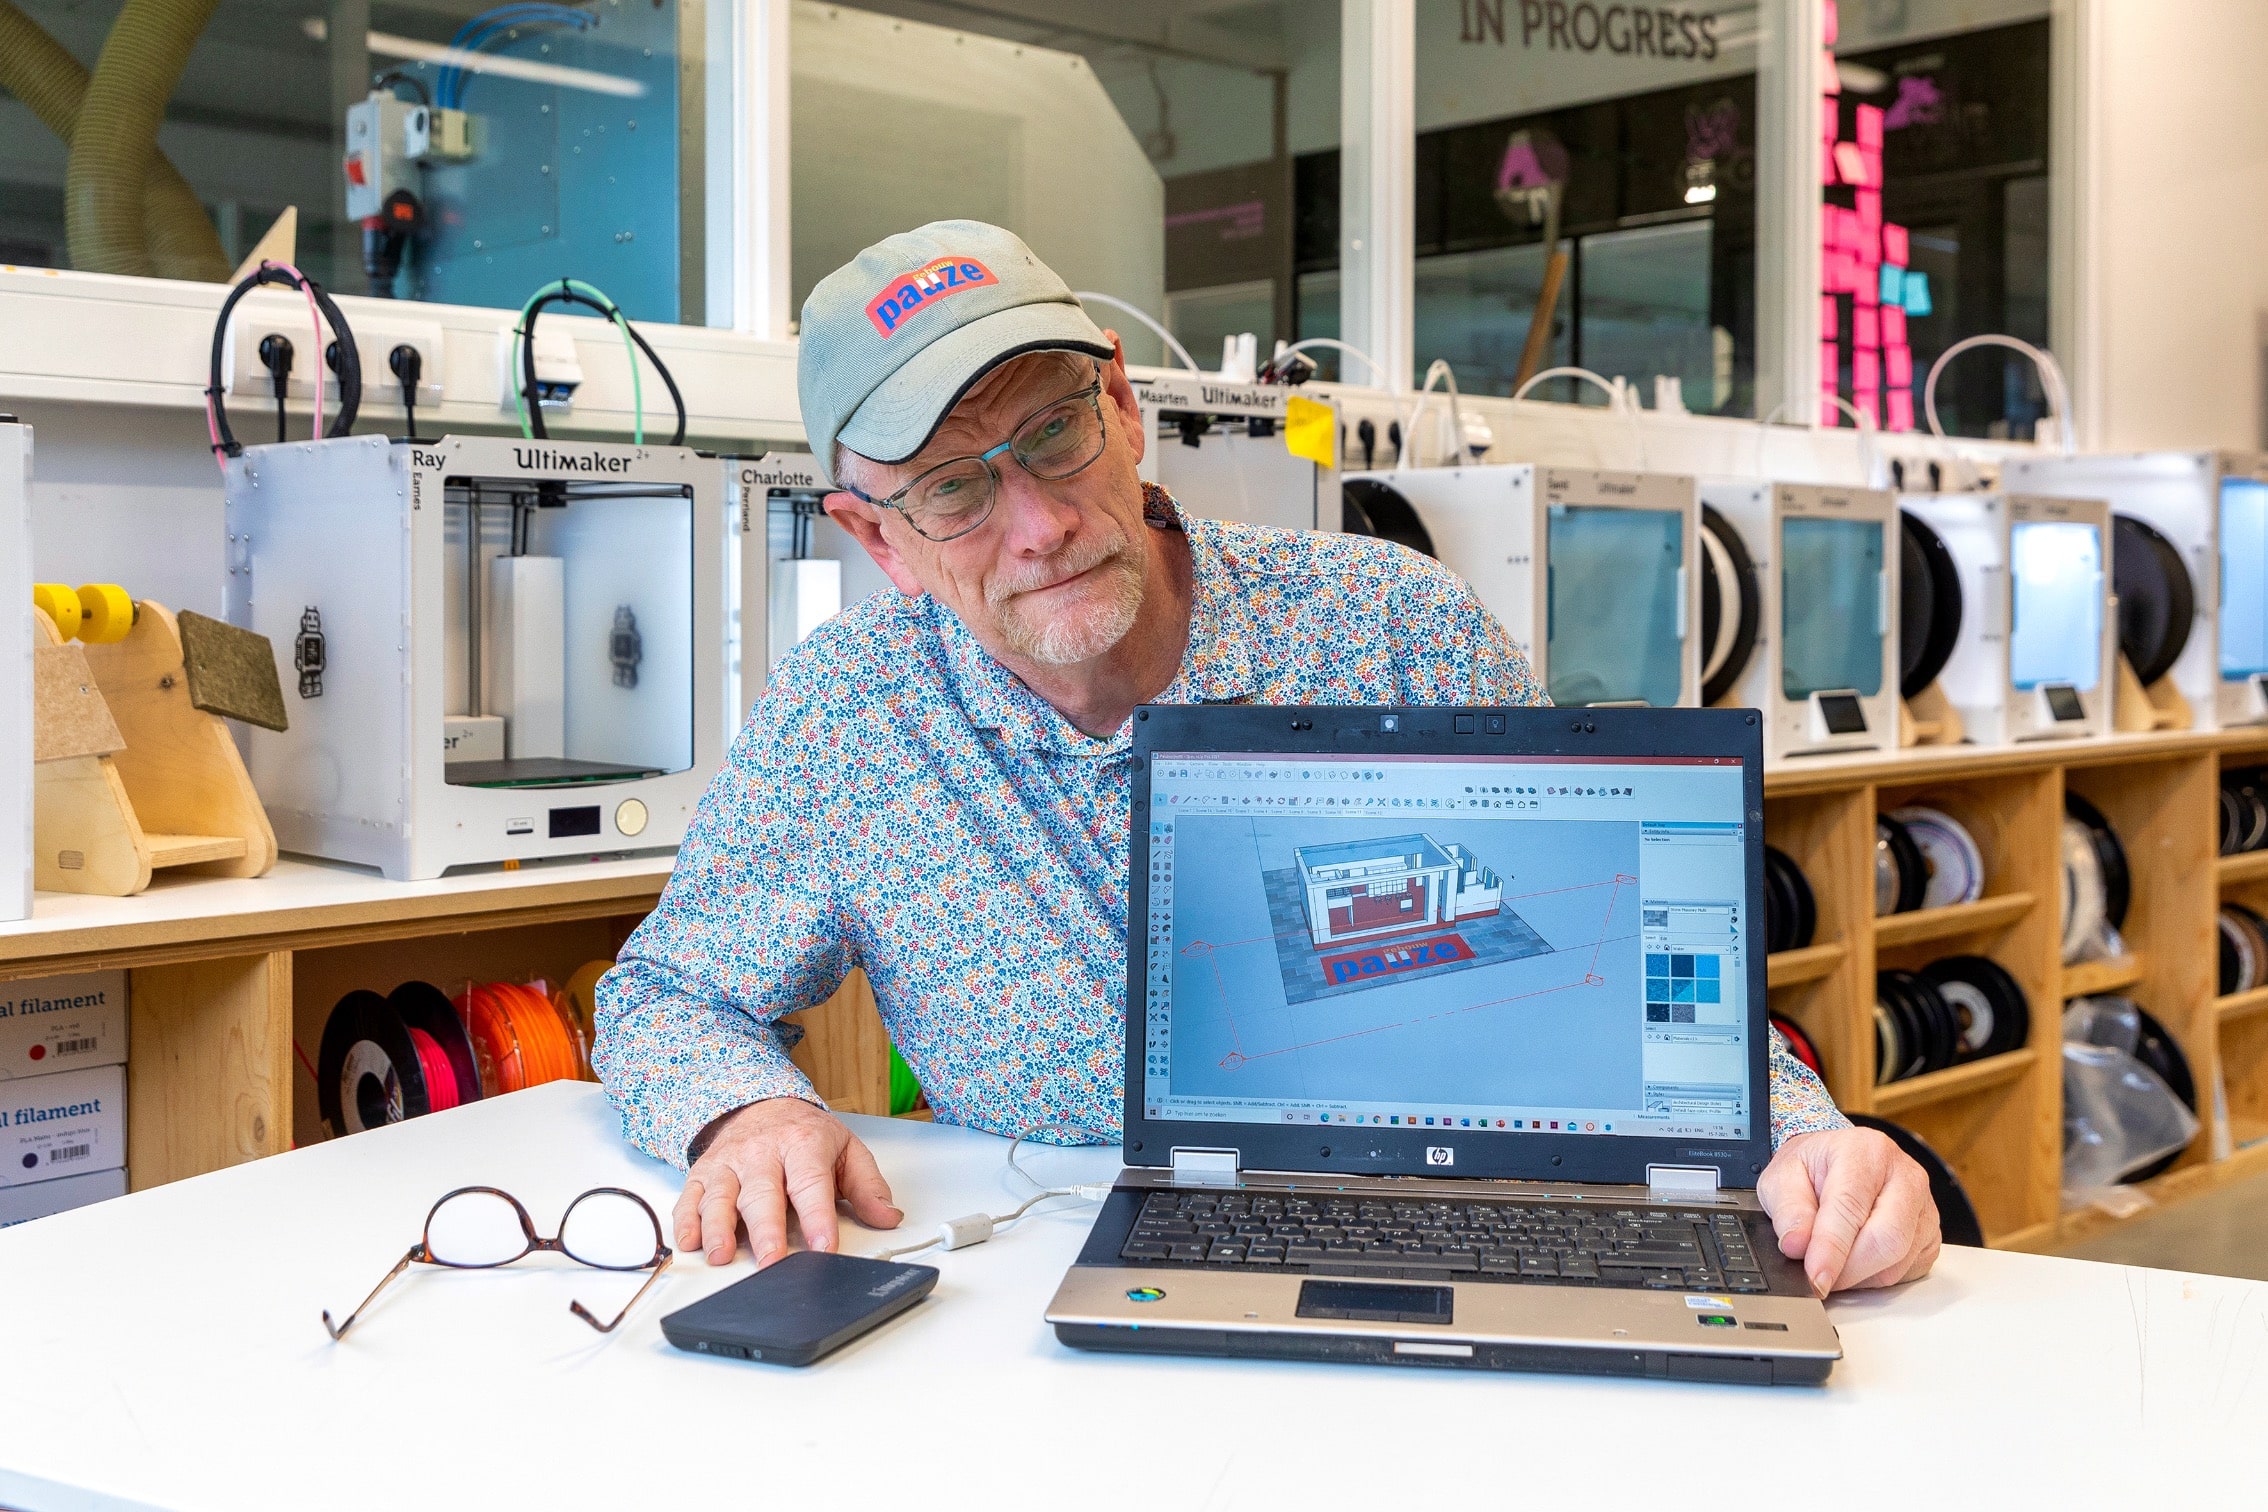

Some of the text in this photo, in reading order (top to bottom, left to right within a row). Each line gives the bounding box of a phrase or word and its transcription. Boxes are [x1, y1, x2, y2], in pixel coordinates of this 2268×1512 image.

[1461, 0, 1718, 60] IN PROGRESS
[912, 260, 954, 280] gebouw
[876, 263, 985, 331] pauze
[1139, 388, 1189, 407] Maarten
[1200, 385, 1277, 409] Ultimaker
[412, 449, 447, 471] Ray
[513, 447, 632, 473] Ultimaker
[741, 468, 814, 486] Charlotte
[412, 471, 422, 511] Eames
[1382, 941, 1429, 954] gebouw
[1331, 942, 1460, 983] pauze
[20, 991, 106, 1015] filament
[14, 1098, 102, 1126] filament
[1432, 1147, 1447, 1162] hp
[1688, 1150, 1714, 1158] EliteBook
